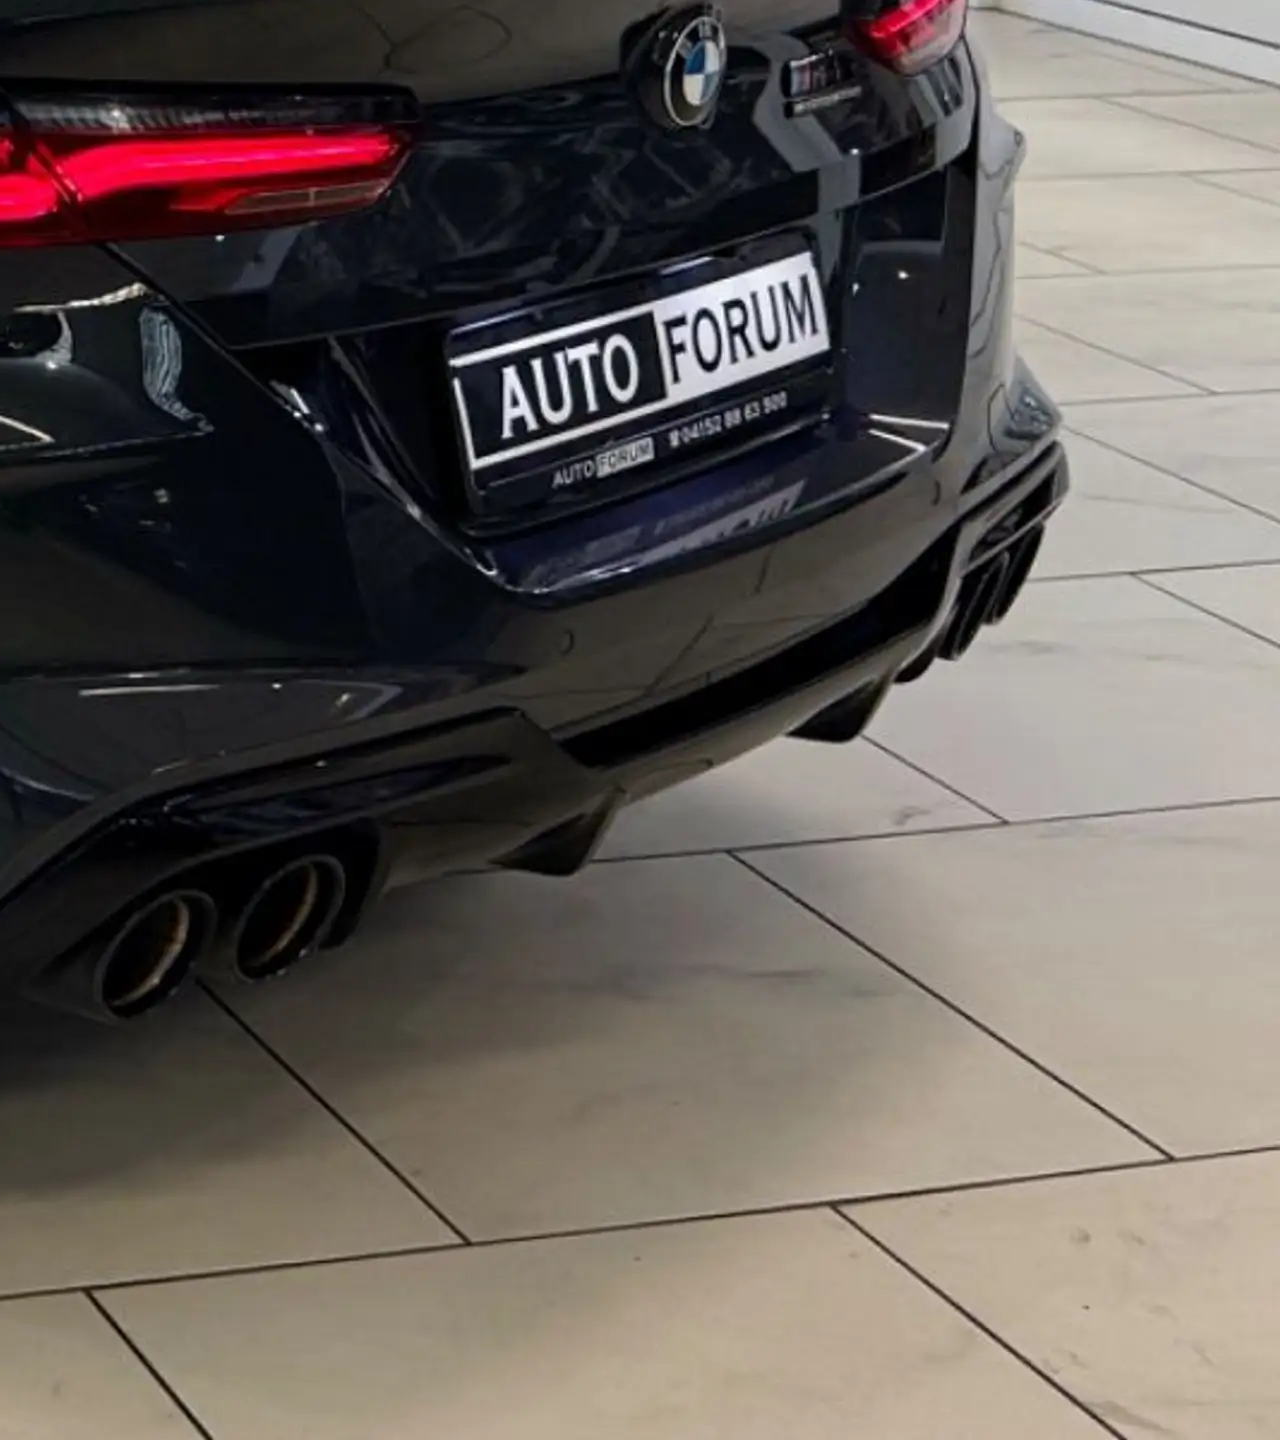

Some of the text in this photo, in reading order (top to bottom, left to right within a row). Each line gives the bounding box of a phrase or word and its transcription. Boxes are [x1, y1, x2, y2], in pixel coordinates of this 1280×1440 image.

[500, 274, 818, 440] AUTO FORUM
[551, 440, 653, 489] AUTO FORUM
